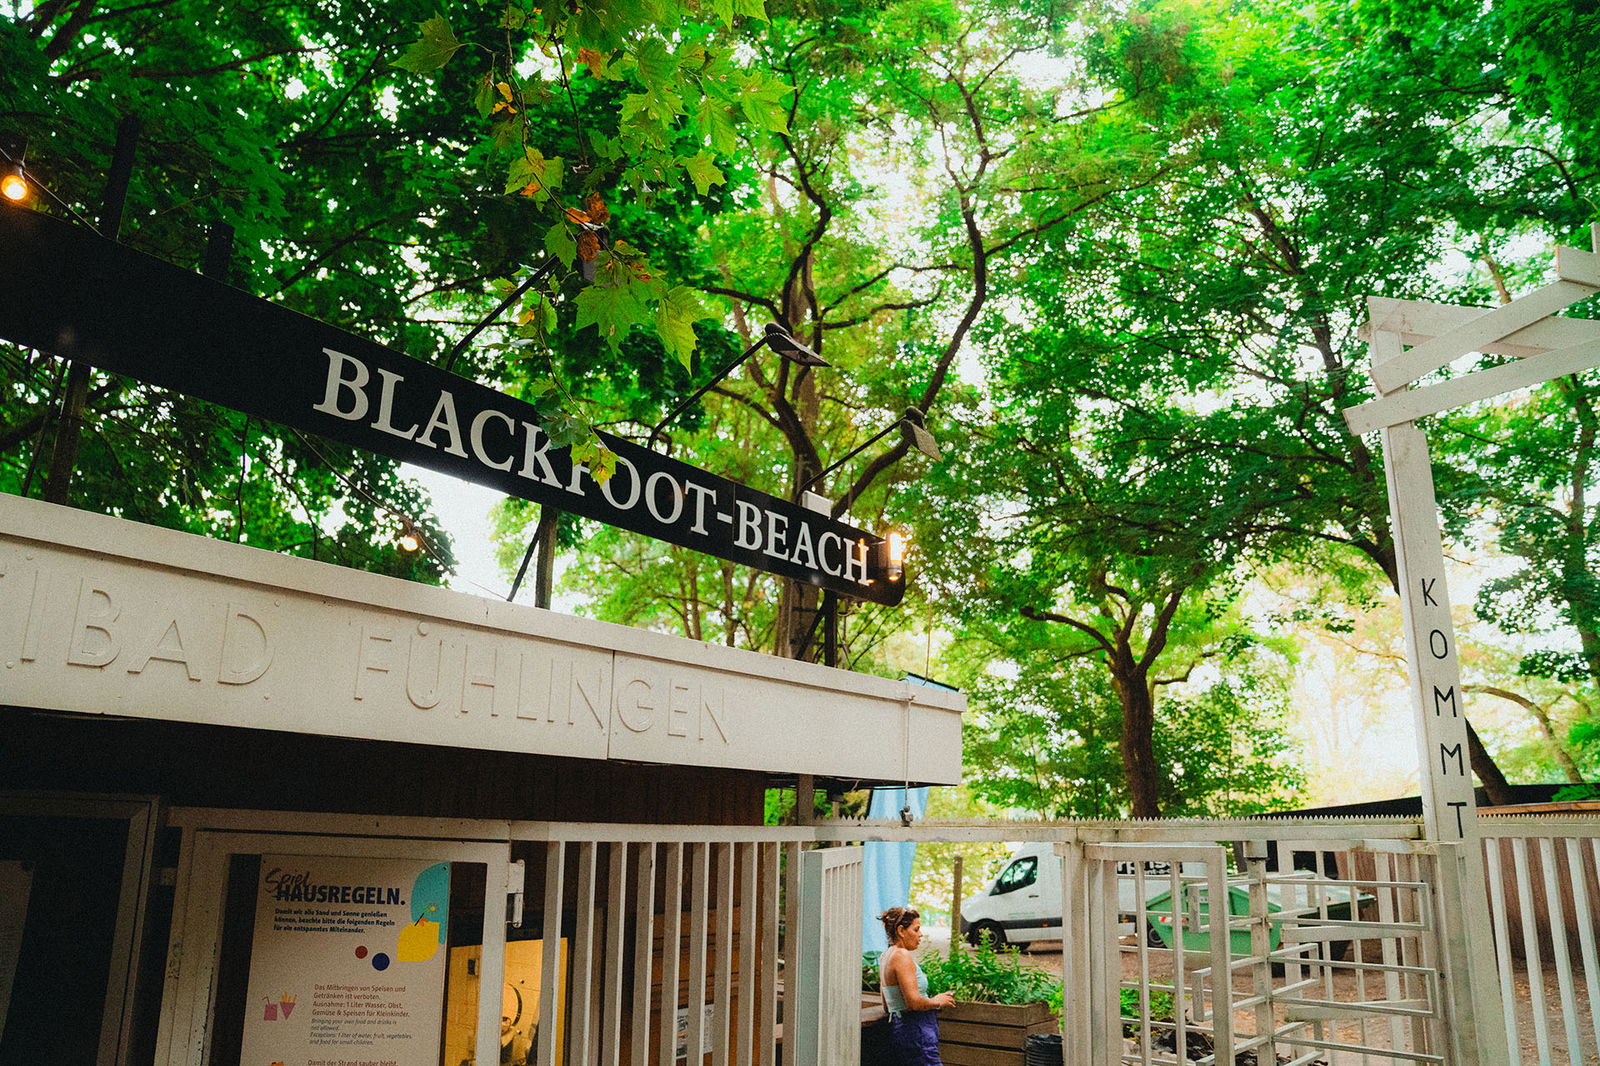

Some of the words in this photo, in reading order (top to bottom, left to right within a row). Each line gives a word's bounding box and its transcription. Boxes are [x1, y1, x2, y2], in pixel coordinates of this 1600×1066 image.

[0, 566, 276, 687] IBAD
[353, 619, 730, 744] FÜHLINGEN
[1420, 578, 1467, 839] KOMMT
[275, 883, 406, 906] HAUSREGELN.
[330, 909, 342, 917] und
[360, 910, 388, 920] genießen
[322, 917, 335, 925] bitte
[346, 918, 375, 928] folgenden
[376, 919, 396, 928] Regeln
[326, 984, 359, 993] Mitbringen
[371, 985, 393, 994] Speisen
[343, 1009, 365, 1018] Speisen
